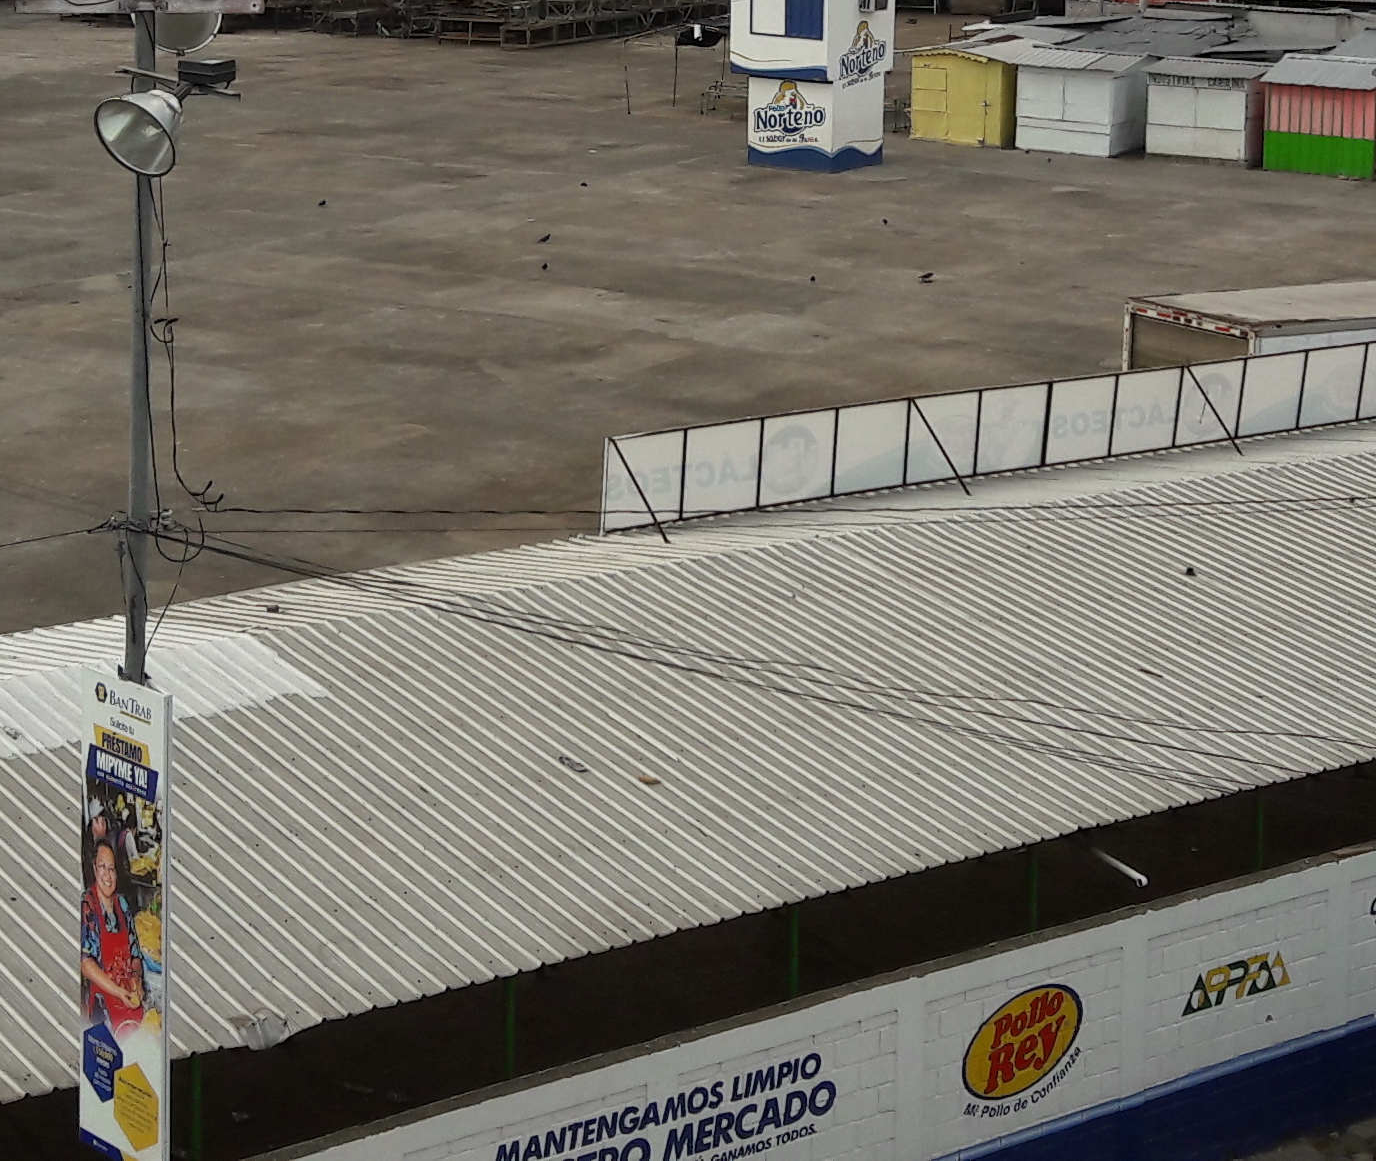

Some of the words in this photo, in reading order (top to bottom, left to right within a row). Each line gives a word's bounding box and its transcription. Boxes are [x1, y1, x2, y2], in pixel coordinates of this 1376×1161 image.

[756, 106, 824, 134] Norteño
[96, 749, 133, 782] MIPYME
[134, 765, 148, 789] YA!
[101, 731, 142, 763] PRÉSTAMO
[991, 991, 1064, 1049] Pollo
[980, 1104, 1010, 1118] Pollo
[1014, 1099, 1028, 1112] de
[1030, 1046, 1082, 1104] Confianza
[984, 1015, 1066, 1094] Rey
[495, 1081, 724, 1161] MANTENGAMOS
[730, 1052, 822, 1102] LIMPIO
[661, 1080, 837, 1161] MERCADO
